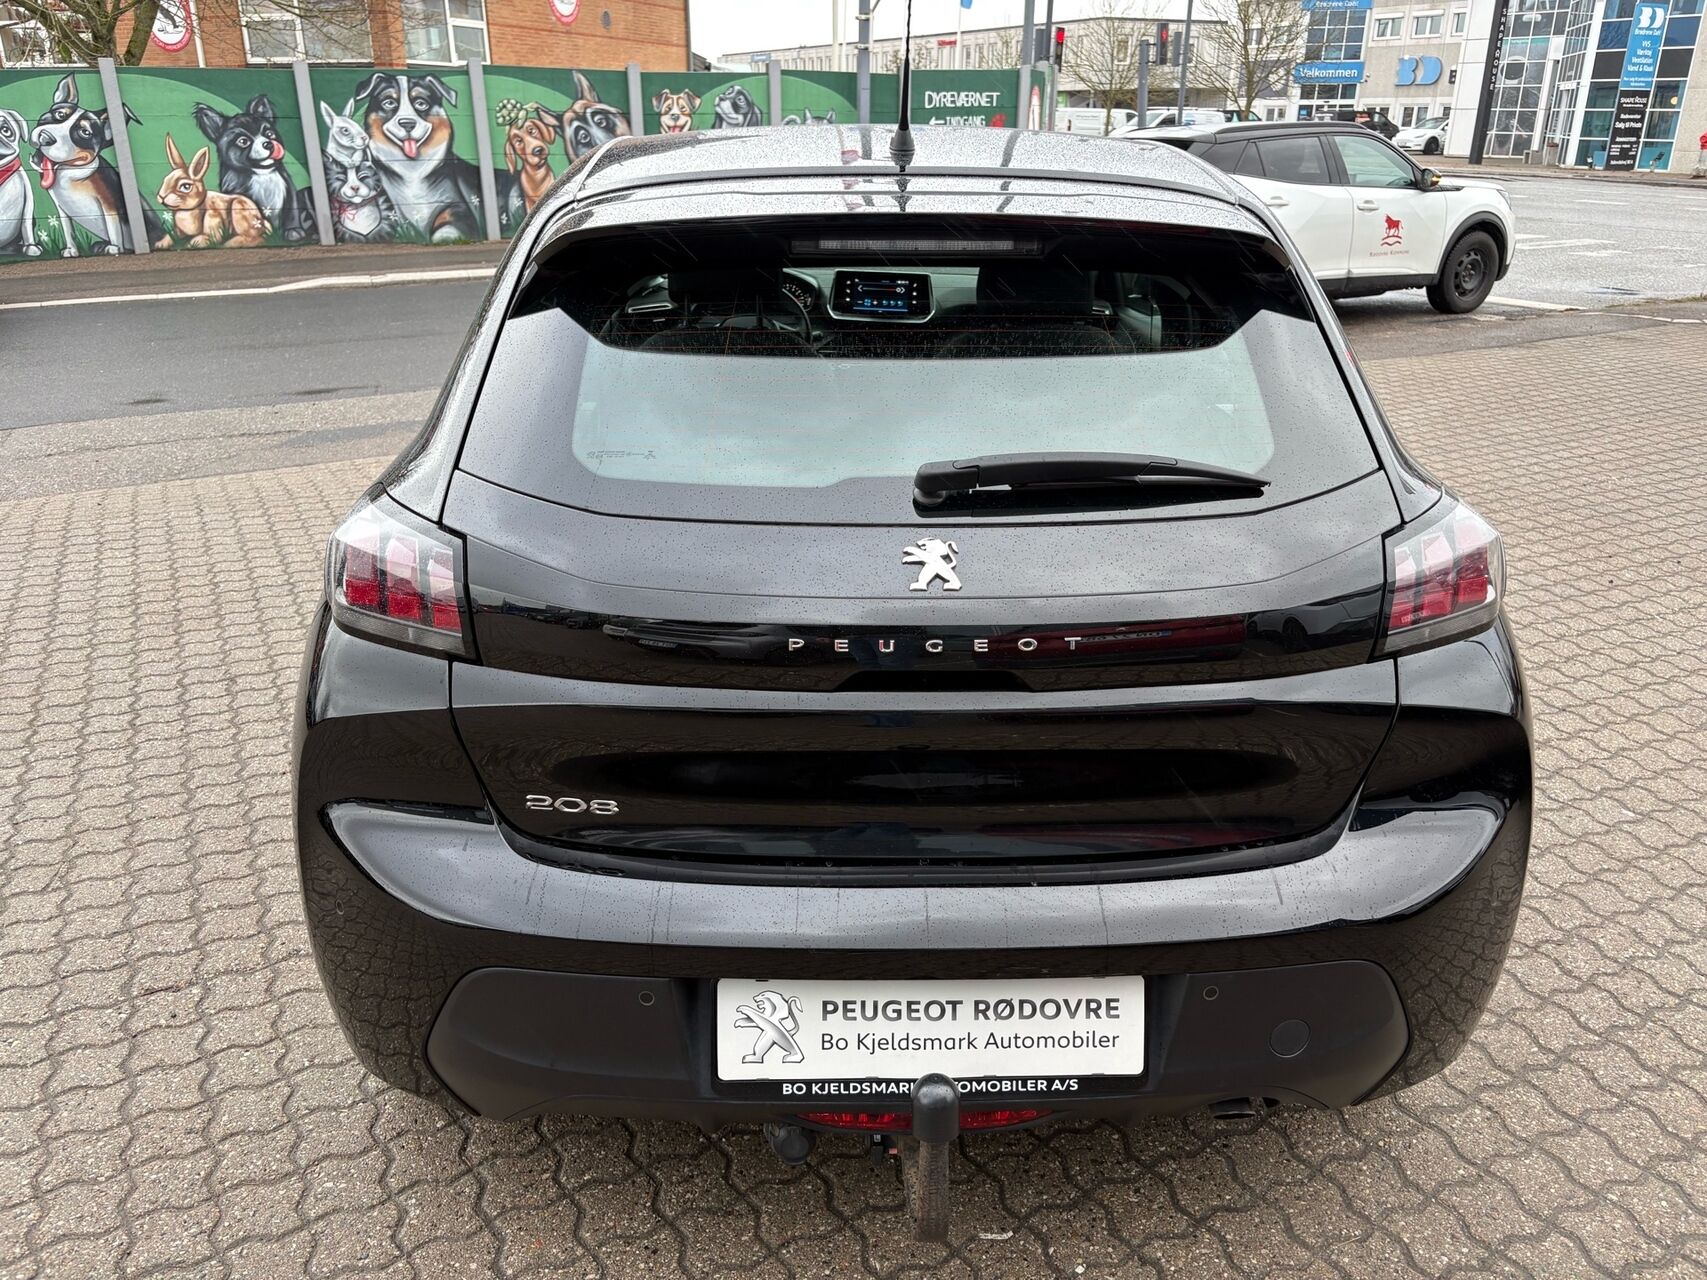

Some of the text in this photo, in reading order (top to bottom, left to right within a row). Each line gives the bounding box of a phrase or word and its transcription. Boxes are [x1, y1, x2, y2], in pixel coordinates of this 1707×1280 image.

[924, 91, 1001, 108] DYREVÆRNET
[788, 637, 1082, 653] PEUGEOT
[525, 794, 620, 815] 208
[821, 998, 1121, 1022] PEUGEOT RØDOVRE
[821, 1030, 1120, 1055] Bo Kjeldsmark Automobiler
[782, 1083, 807, 1095] BO
[1051, 1079, 1079, 1091] A/S
